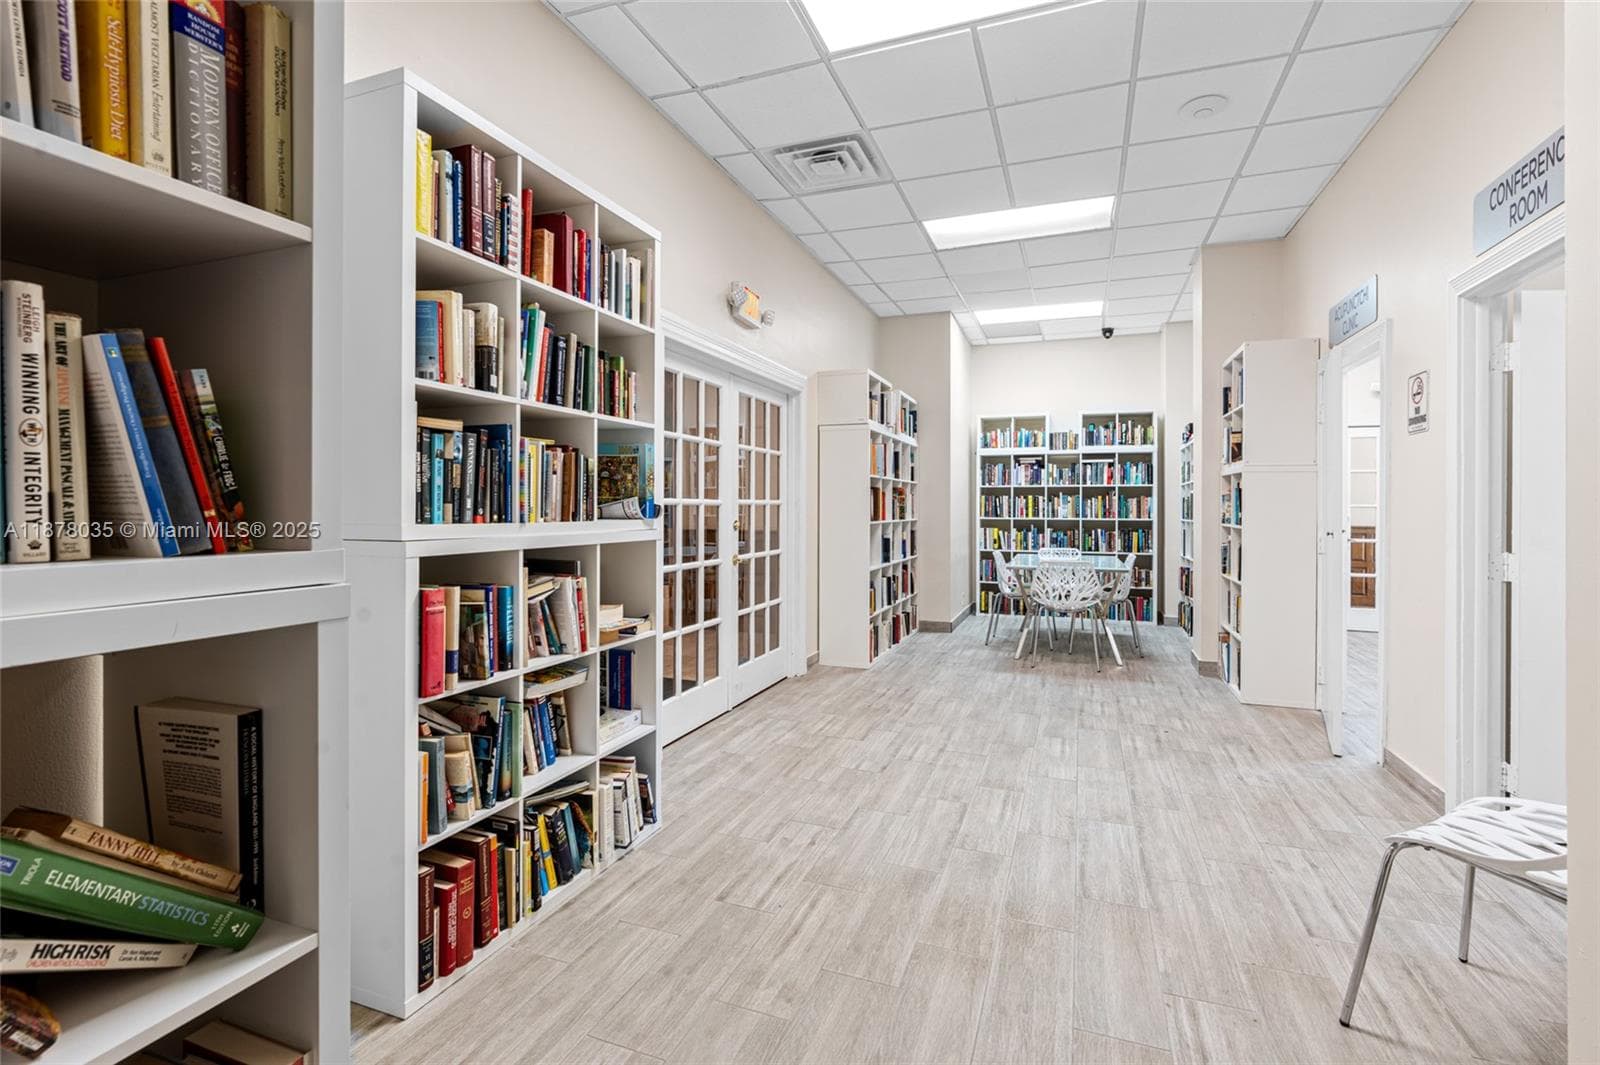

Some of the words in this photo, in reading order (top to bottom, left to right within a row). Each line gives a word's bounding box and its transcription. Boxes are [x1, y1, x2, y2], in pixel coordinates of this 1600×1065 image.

[183, 25, 224, 51] WEBSTER'S
[187, 11, 221, 34] RANDOM
[191, 21, 217, 41] HOUSE
[58, 29, 73, 82] METHOD
[151, 37, 161, 90] VEGETARIAN
[199, 46, 221, 130] MODERN
[110, 110, 125, 141] Diet
[187, 41, 203, 188] DICTIONARY
[205, 133, 223, 195] OFFICE
[1489, 135, 1565, 211] CONFERENC
[1509, 180, 1548, 228] ROOM
[21, 293, 33, 344] STEINBERG
[31, 306, 41, 333] LEIGH
[54, 322, 67, 338] THE
[55, 340, 68, 355] ART
[55, 356, 69, 368] OF
[21, 353, 40, 415] WINNING
[58, 408, 72, 462] MANAGEMENT
[23, 452, 43, 525] INTEGRITY
[20, 857, 43, 886] TRIOLA
[87, 831, 133, 856] FANNY
[133, 845, 160, 865] HILL
[45, 869, 142, 907] ELEMENTARY
[138, 896, 210, 926] STATISTICS
[30, 943, 76, 960] HIGH
[74, 944, 116, 960] RISK
